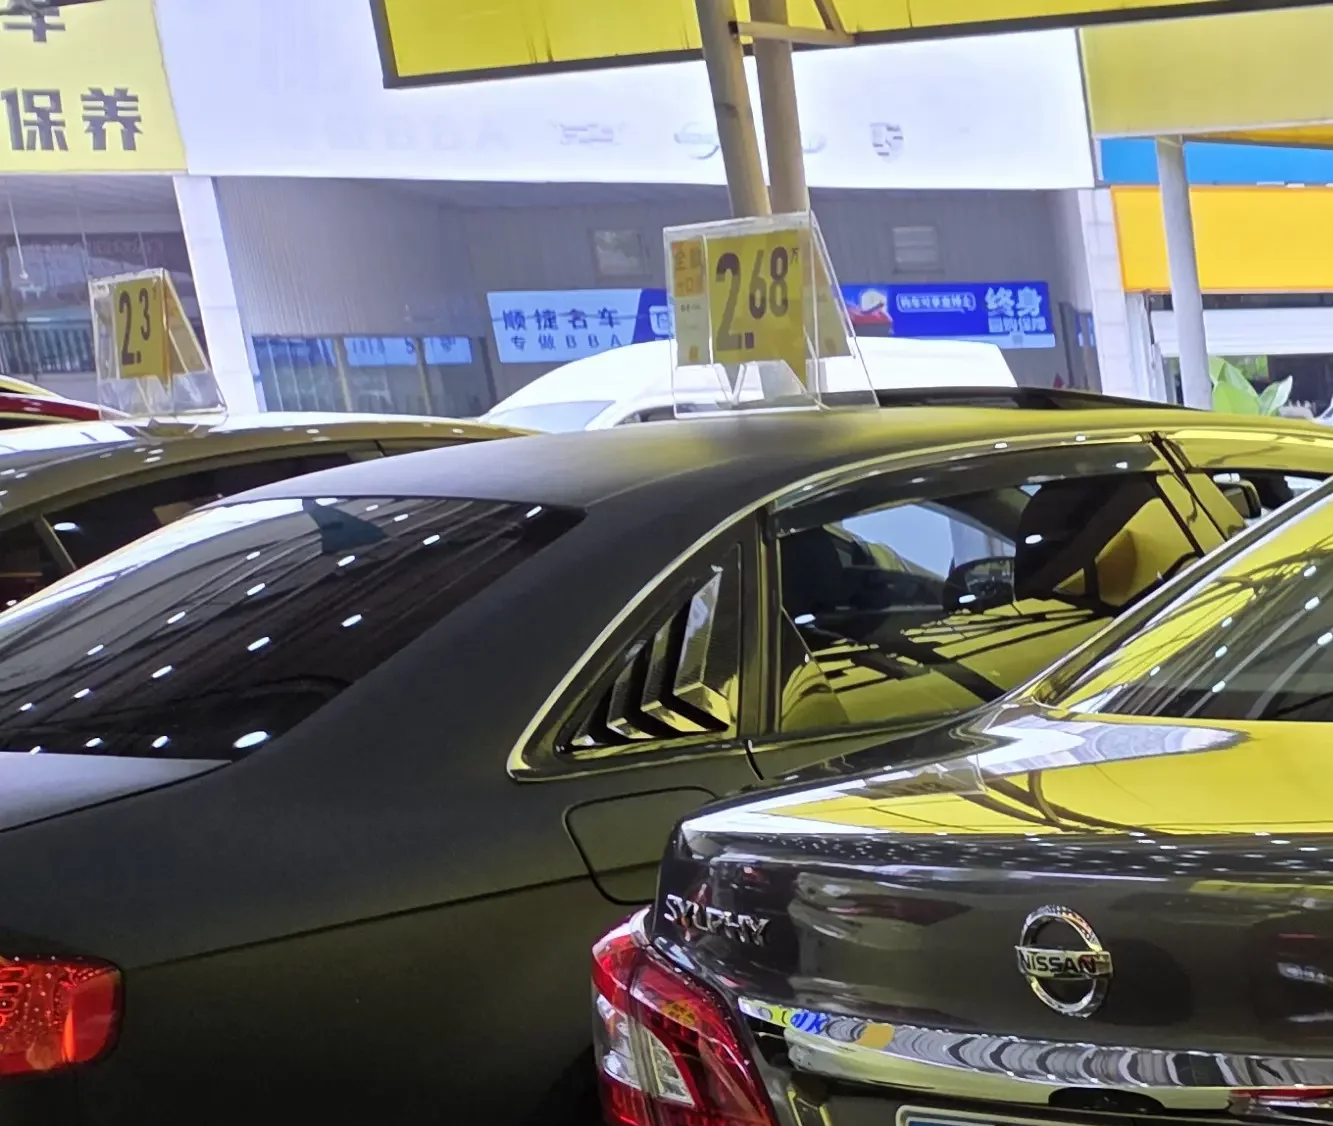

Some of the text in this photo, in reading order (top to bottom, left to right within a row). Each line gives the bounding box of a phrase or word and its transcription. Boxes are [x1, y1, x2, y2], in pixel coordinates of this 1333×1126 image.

[1, 87, 144, 152] 保养
[118, 287, 152, 366] 2.3
[715, 246, 789, 351] 2.68
[663, 893, 770, 947] SYLPHY
[1018, 951, 1098, 974] NISSAN
